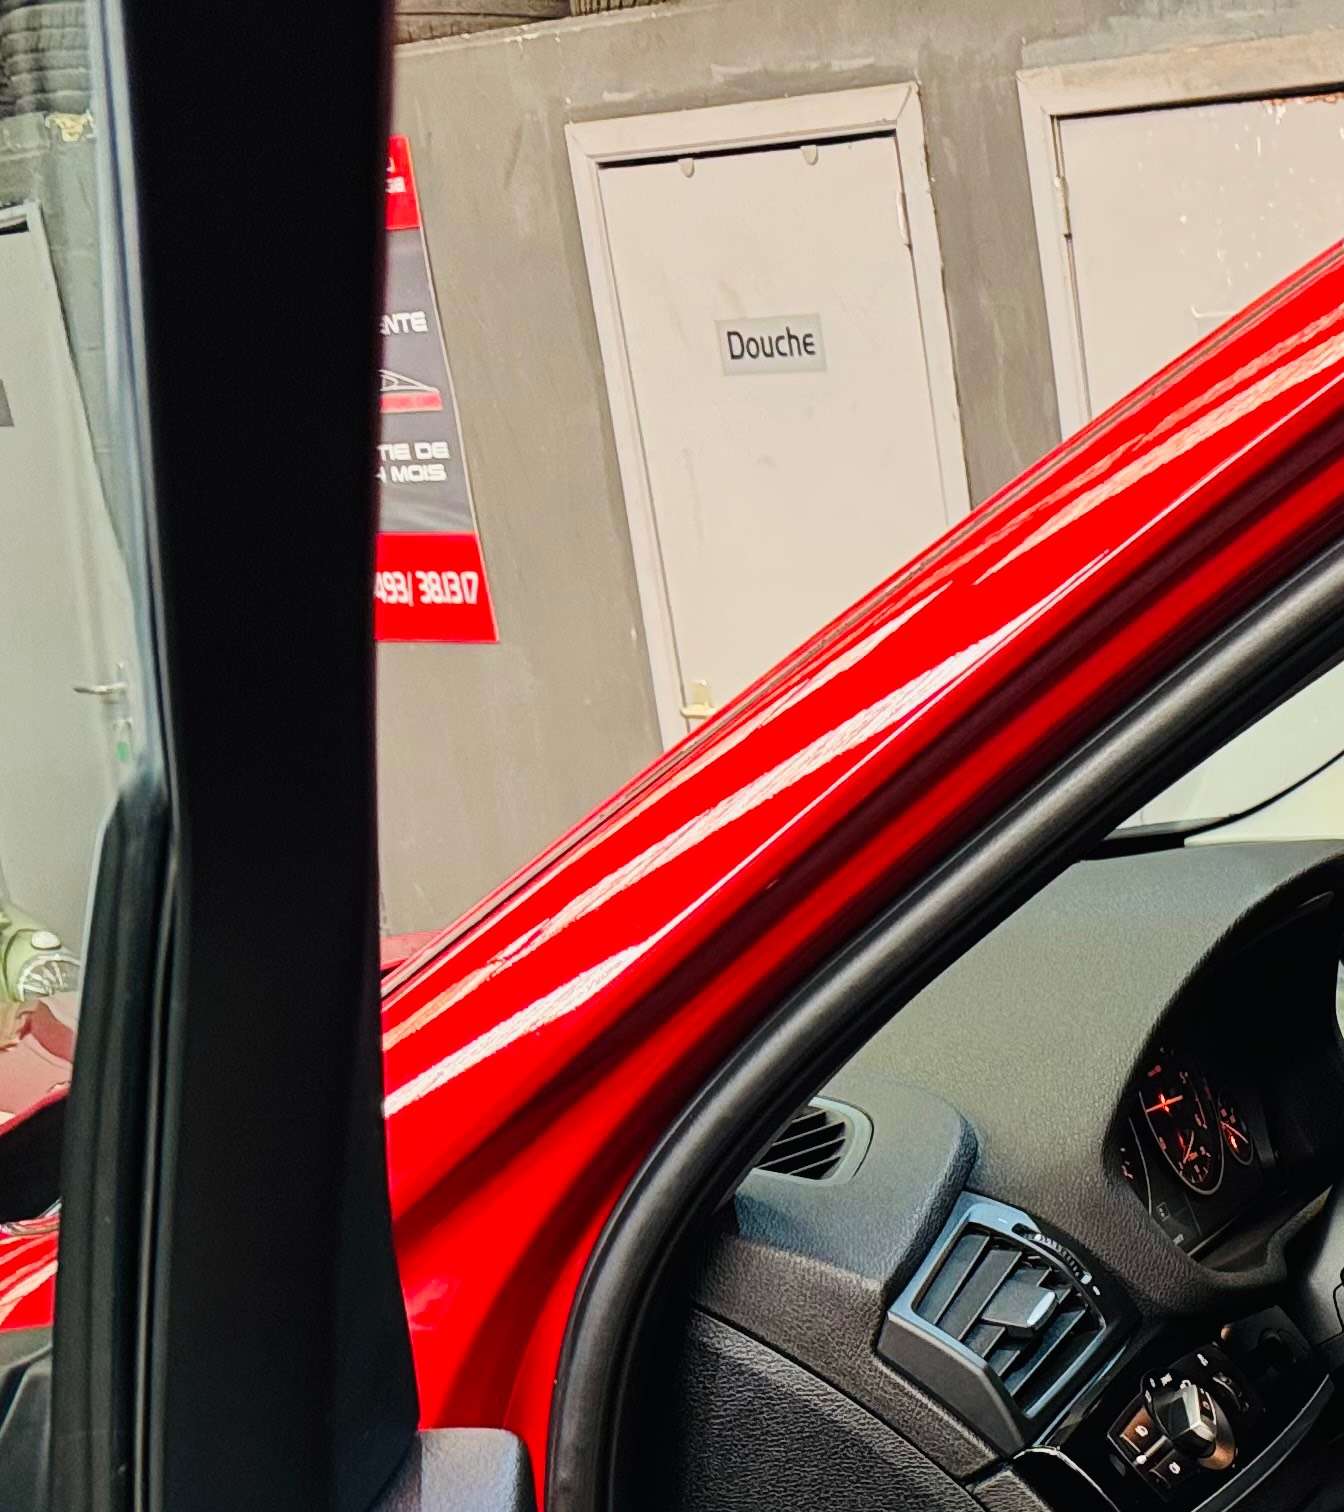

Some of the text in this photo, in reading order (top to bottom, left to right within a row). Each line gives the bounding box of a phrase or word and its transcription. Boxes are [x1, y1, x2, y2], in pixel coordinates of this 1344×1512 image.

[727, 326, 816, 360] Douche
[414, 441, 450, 459] DE
[390, 464, 447, 482] MOIS
